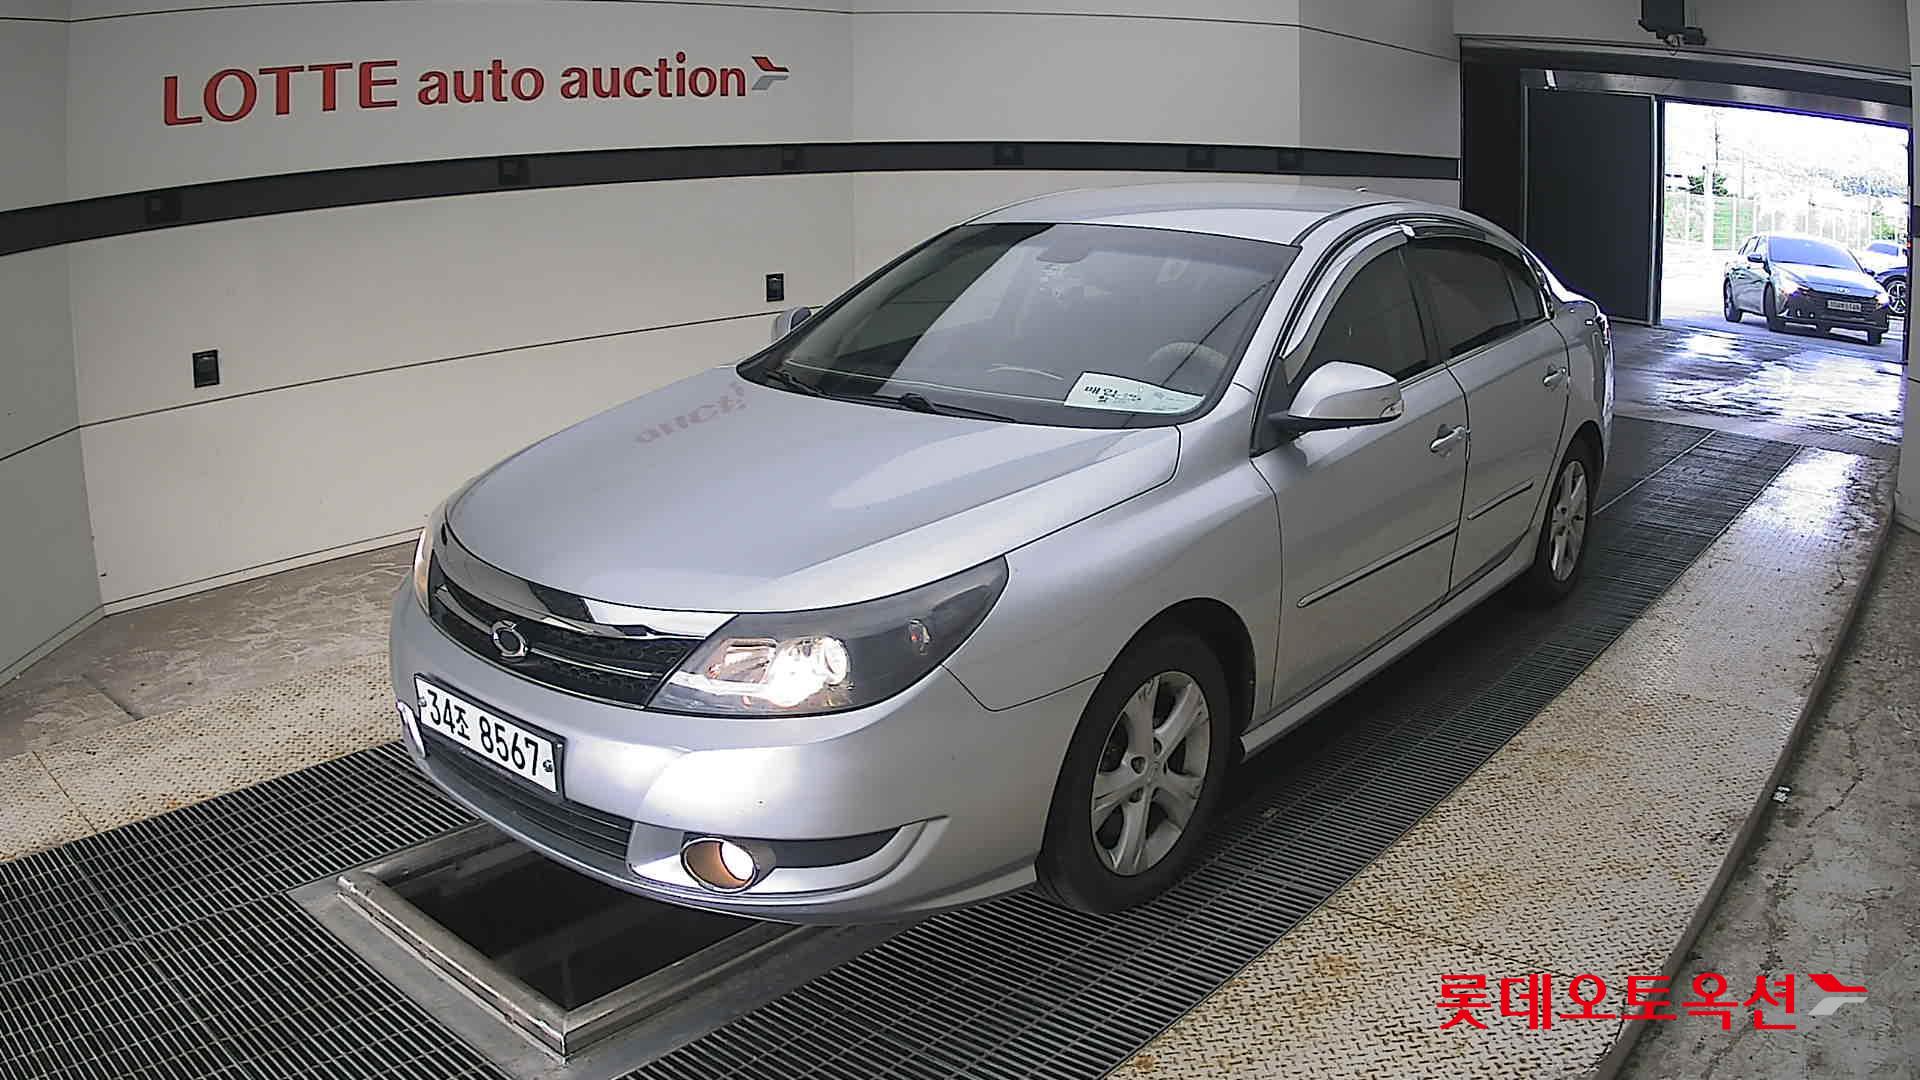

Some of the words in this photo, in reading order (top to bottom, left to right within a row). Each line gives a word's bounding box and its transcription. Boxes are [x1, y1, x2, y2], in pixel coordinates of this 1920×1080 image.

[163, 61, 398, 126] LOTTE
[417, 60, 545, 105] auto
[560, 52, 746, 97] auction
[427, 689, 471, 742] 34조
[479, 715, 539, 776] 8567
